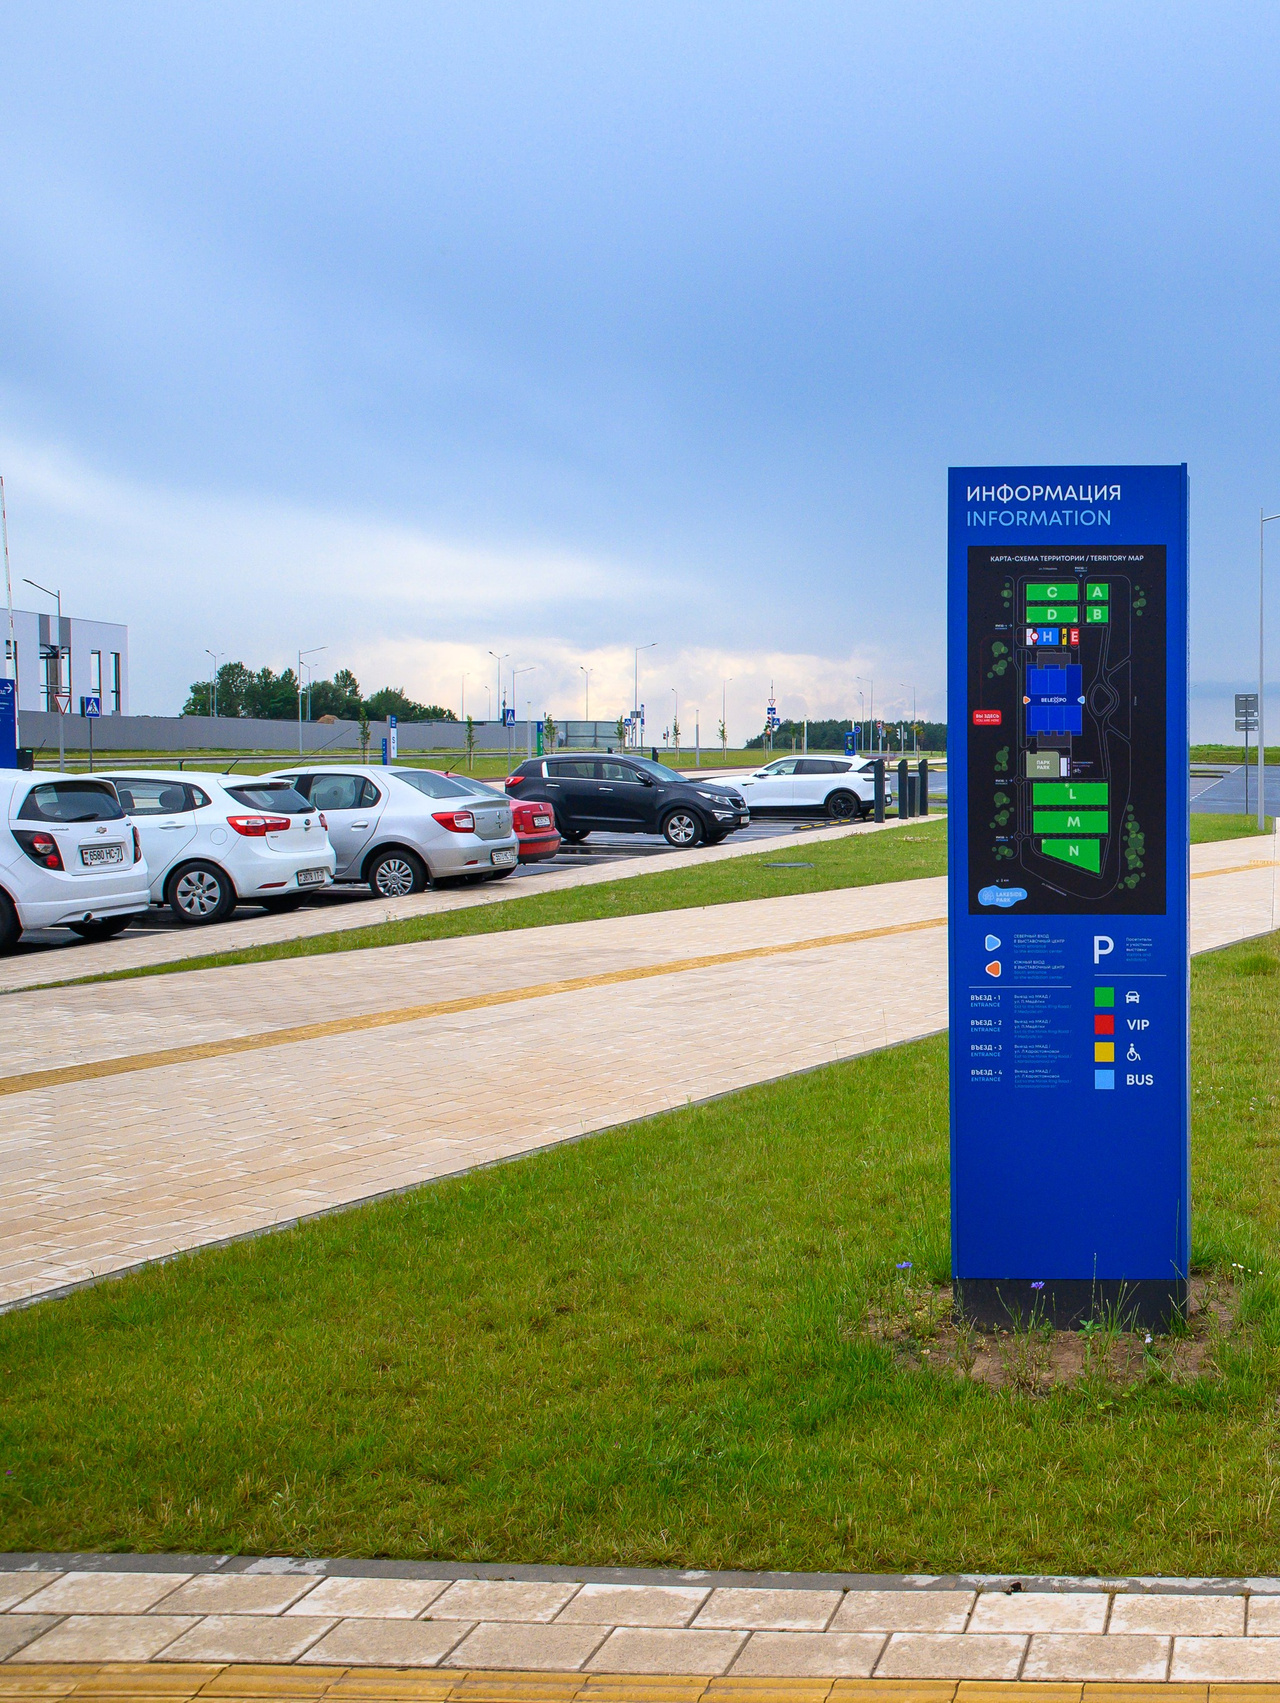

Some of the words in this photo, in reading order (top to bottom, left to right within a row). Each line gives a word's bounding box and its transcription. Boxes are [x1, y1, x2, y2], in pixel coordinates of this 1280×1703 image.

[966, 483, 1121, 504] ИНФОРМАЦИЯ
[966, 509, 1111, 527] INFORMATION
[1047, 587, 1058, 598] C
[1092, 586, 1103, 598] A
[1047, 609, 1058, 620] D
[1093, 609, 1102, 620] B
[1043, 631, 1052, 642] H
[1071, 631, 1079, 642] E
[1069, 788, 1077, 800] L
[1067, 816, 1081, 828] M
[1069, 845, 1079, 857] N
[1093, 935, 1115, 964] P
[1126, 1018, 1150, 1031] VIP
[1126, 1073, 1154, 1086] BUS
